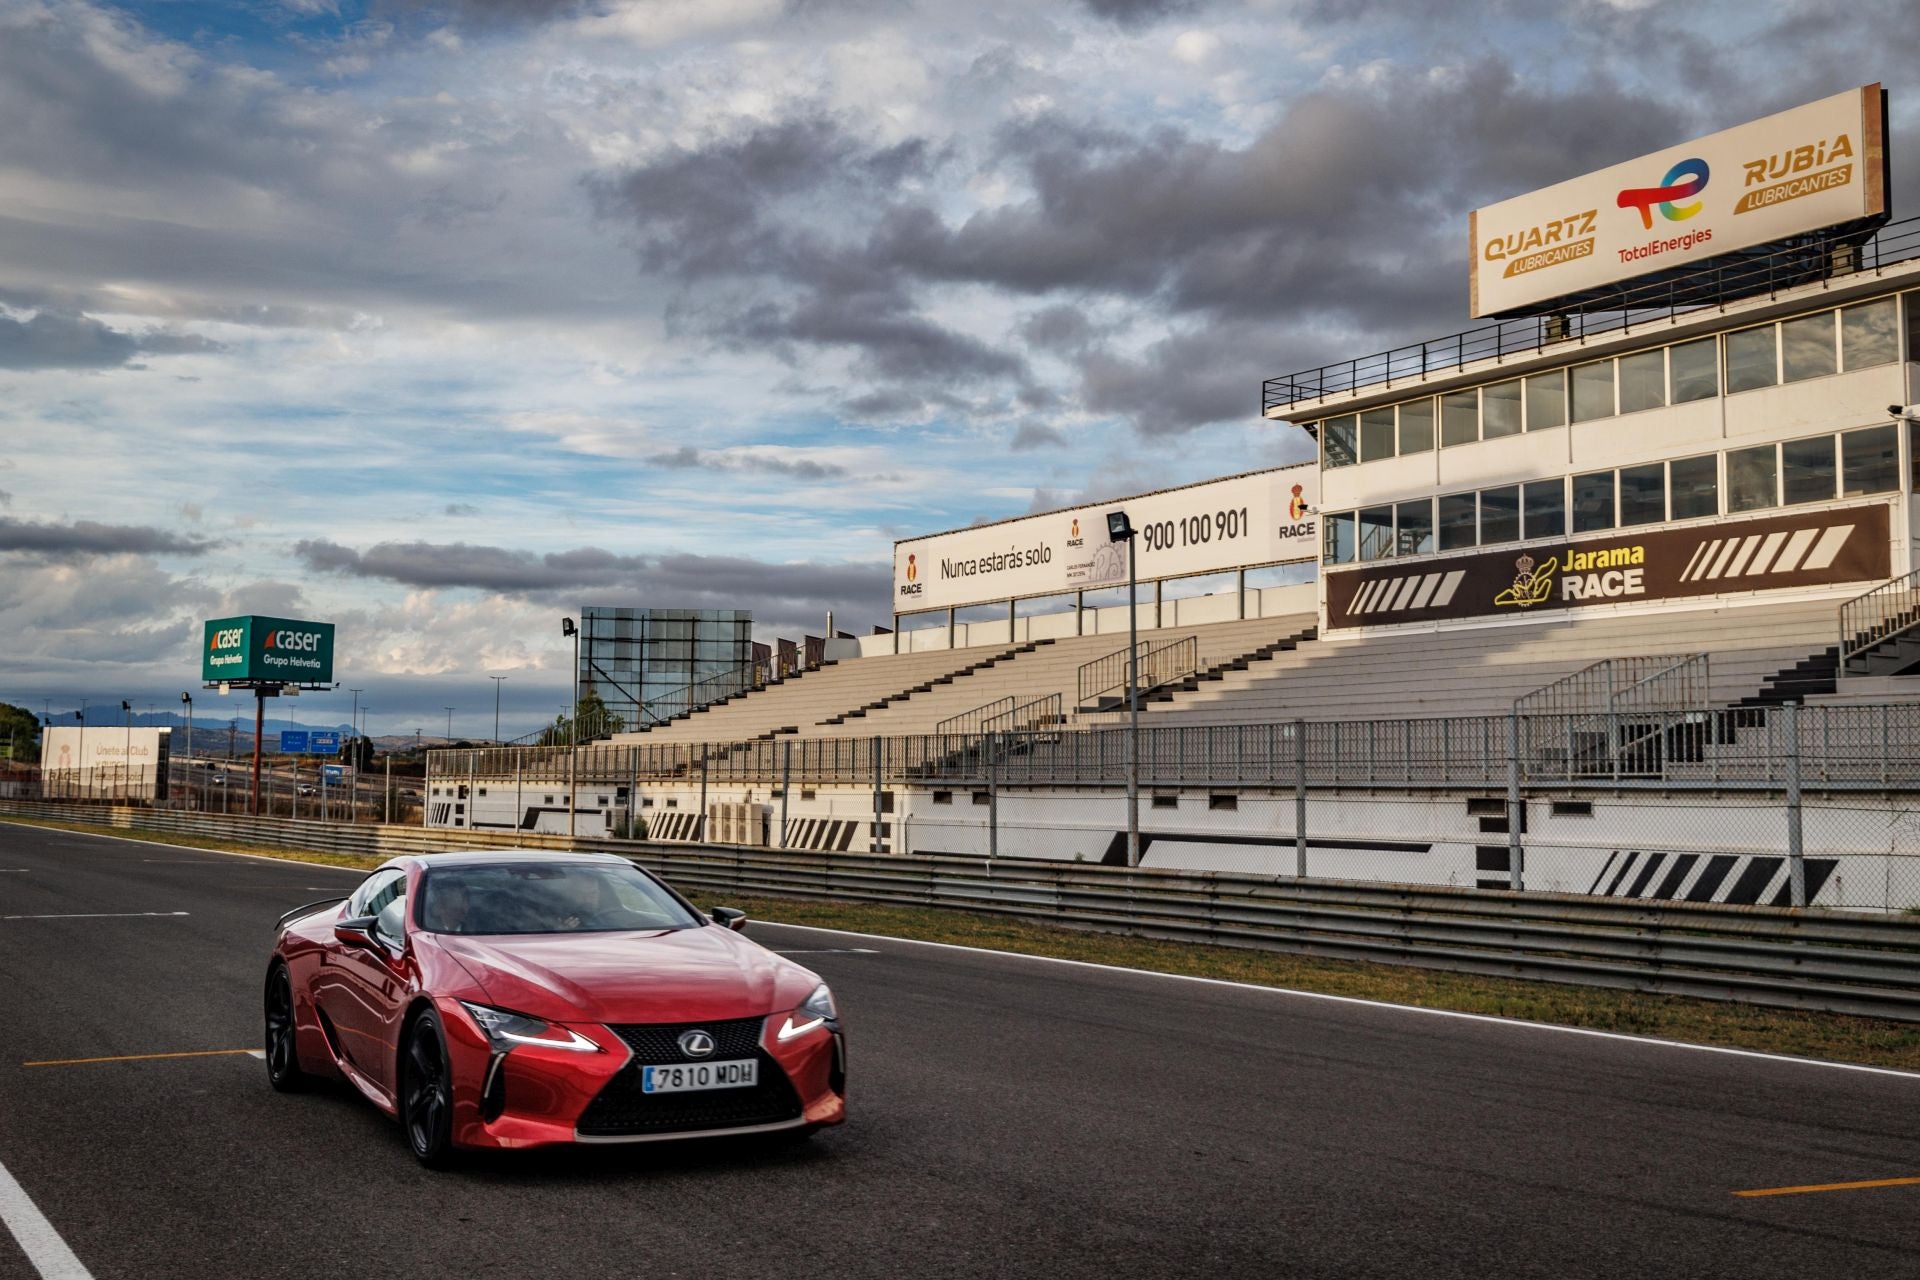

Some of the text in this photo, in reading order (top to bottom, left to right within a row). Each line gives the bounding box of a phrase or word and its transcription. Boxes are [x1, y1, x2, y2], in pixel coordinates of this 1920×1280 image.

[1747, 168, 1847, 209] LUBRICANTES
[1485, 209, 1597, 261] QUARTZ
[1618, 229, 1712, 263] TotalEnergies
[1513, 240, 1591, 274] LUBRICANTES
[1143, 507, 1247, 552] 900 100 901
[1279, 522, 1315, 539] RACE
[1066, 539, 1084, 547] RACE
[941, 541, 1051, 580] Nunca estarás solo
[1561, 545, 1645, 572] Jarama
[900, 583, 923, 595] RACE
[1561, 568, 1646, 601] RACE
[217, 628, 244, 650] caser
[275, 630, 322, 652] caser
[263, 653, 321, 669] Grupo Helvetia
[130, 746, 149, 756] Club
[658, 1066, 710, 1088] 7810
